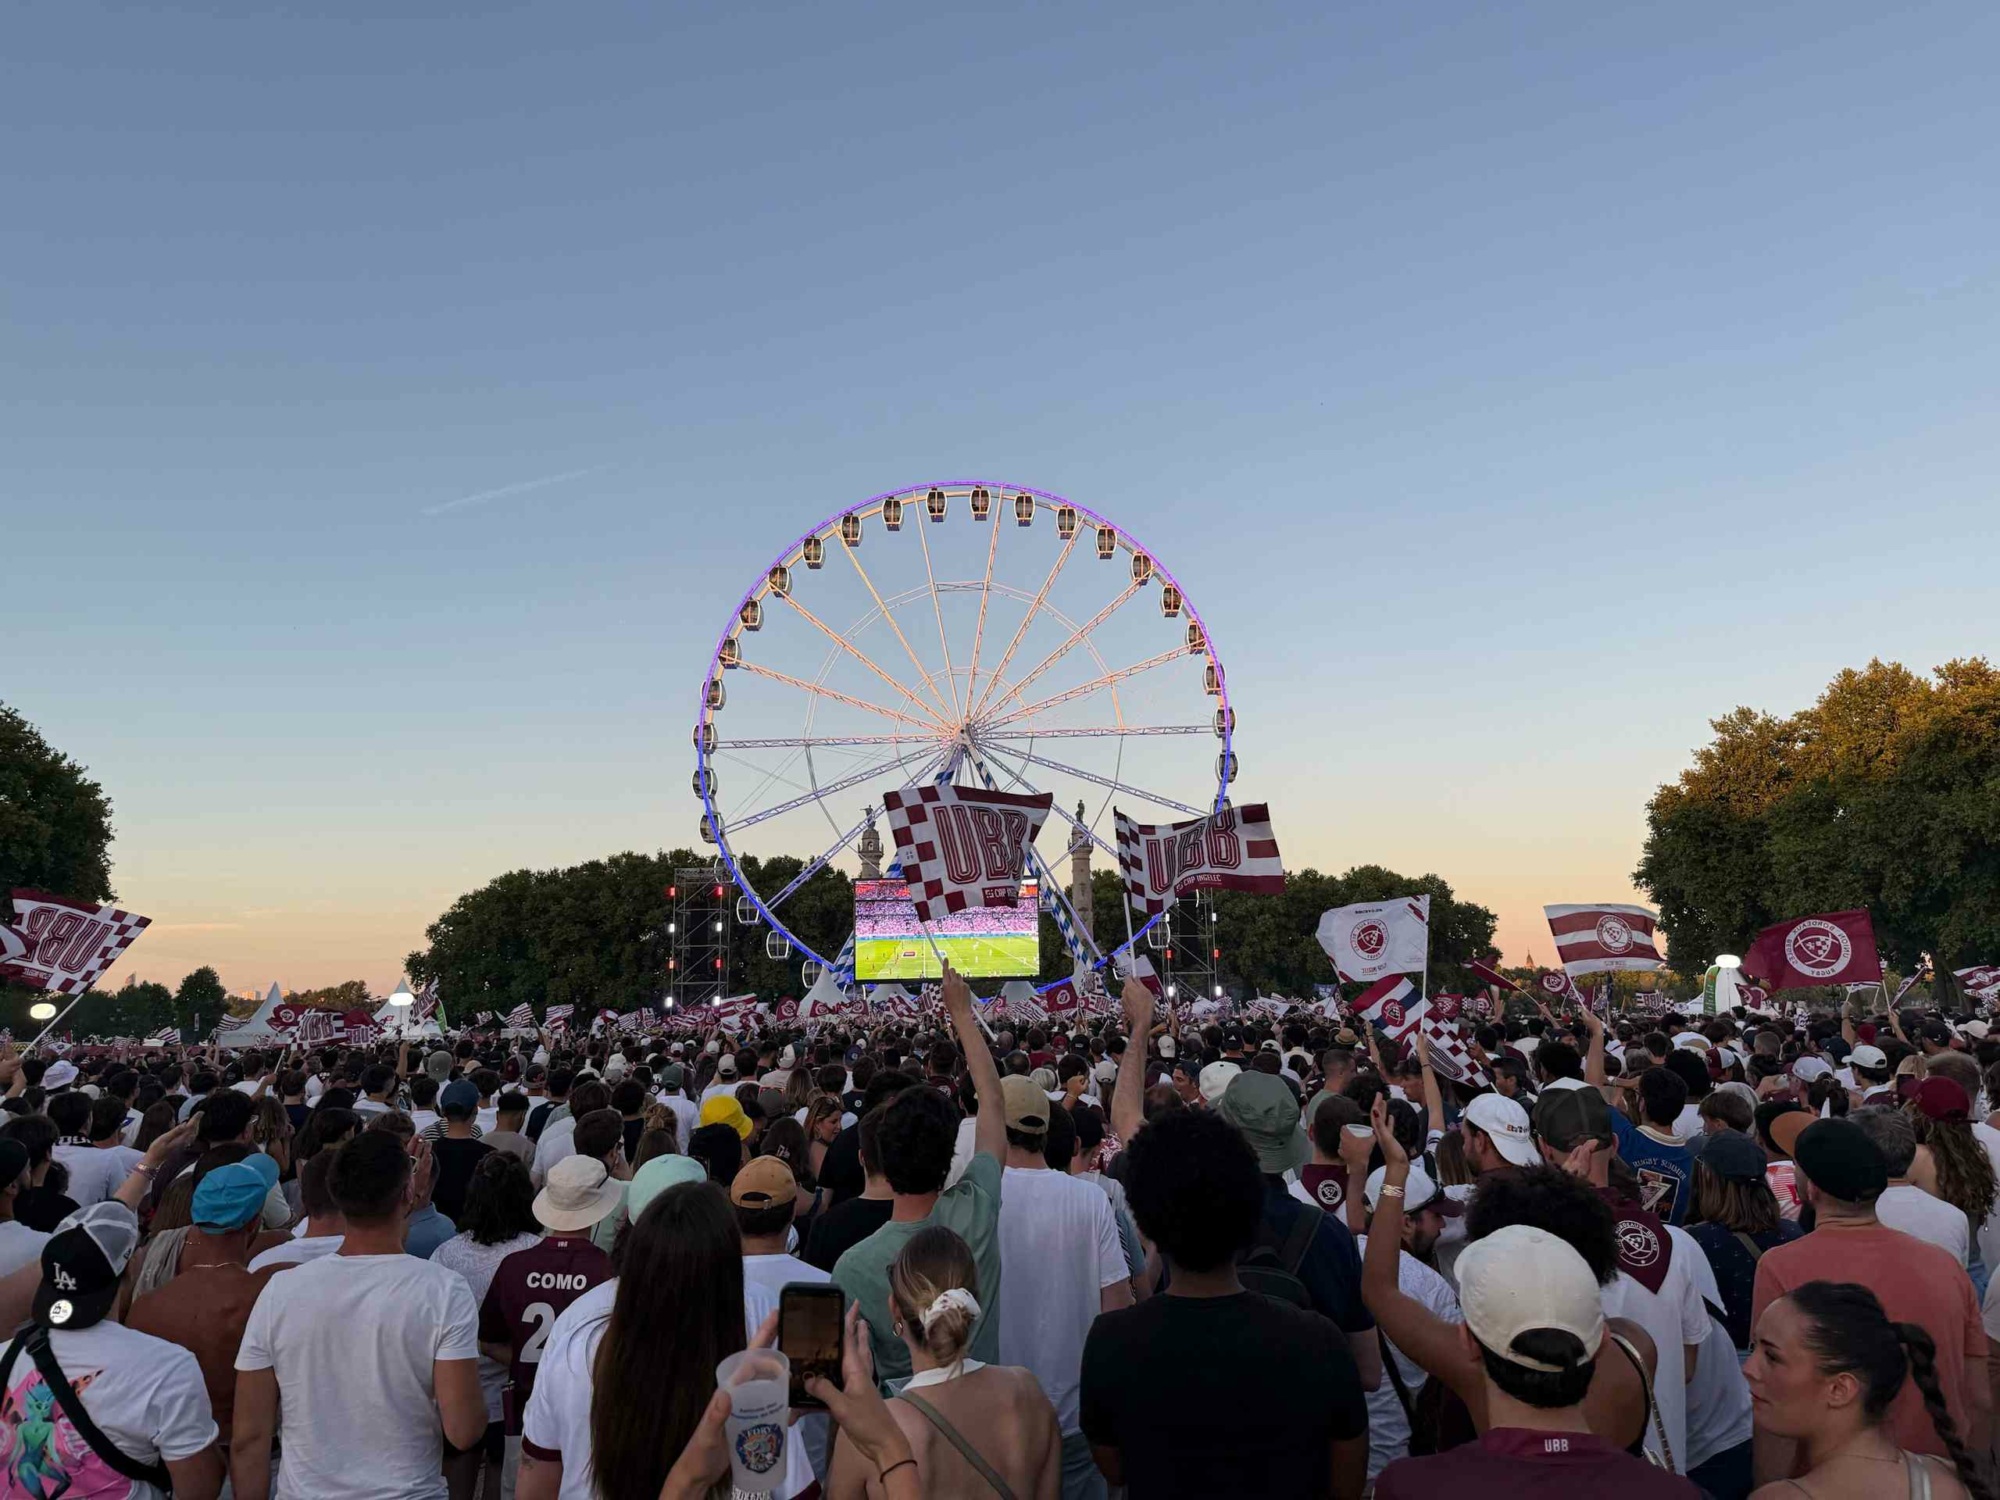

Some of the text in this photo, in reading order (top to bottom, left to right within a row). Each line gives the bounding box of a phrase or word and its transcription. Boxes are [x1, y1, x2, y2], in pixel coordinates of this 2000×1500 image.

[1146, 808, 1242, 895] UBB
[1632, 1158, 1687, 1181] RUGBY SUMMER
[53, 1262, 77, 1290] LA
[526, 1271, 588, 1291] COMO
[519, 1302, 556, 1363] 2
[1544, 1438, 1570, 1453] UBB
